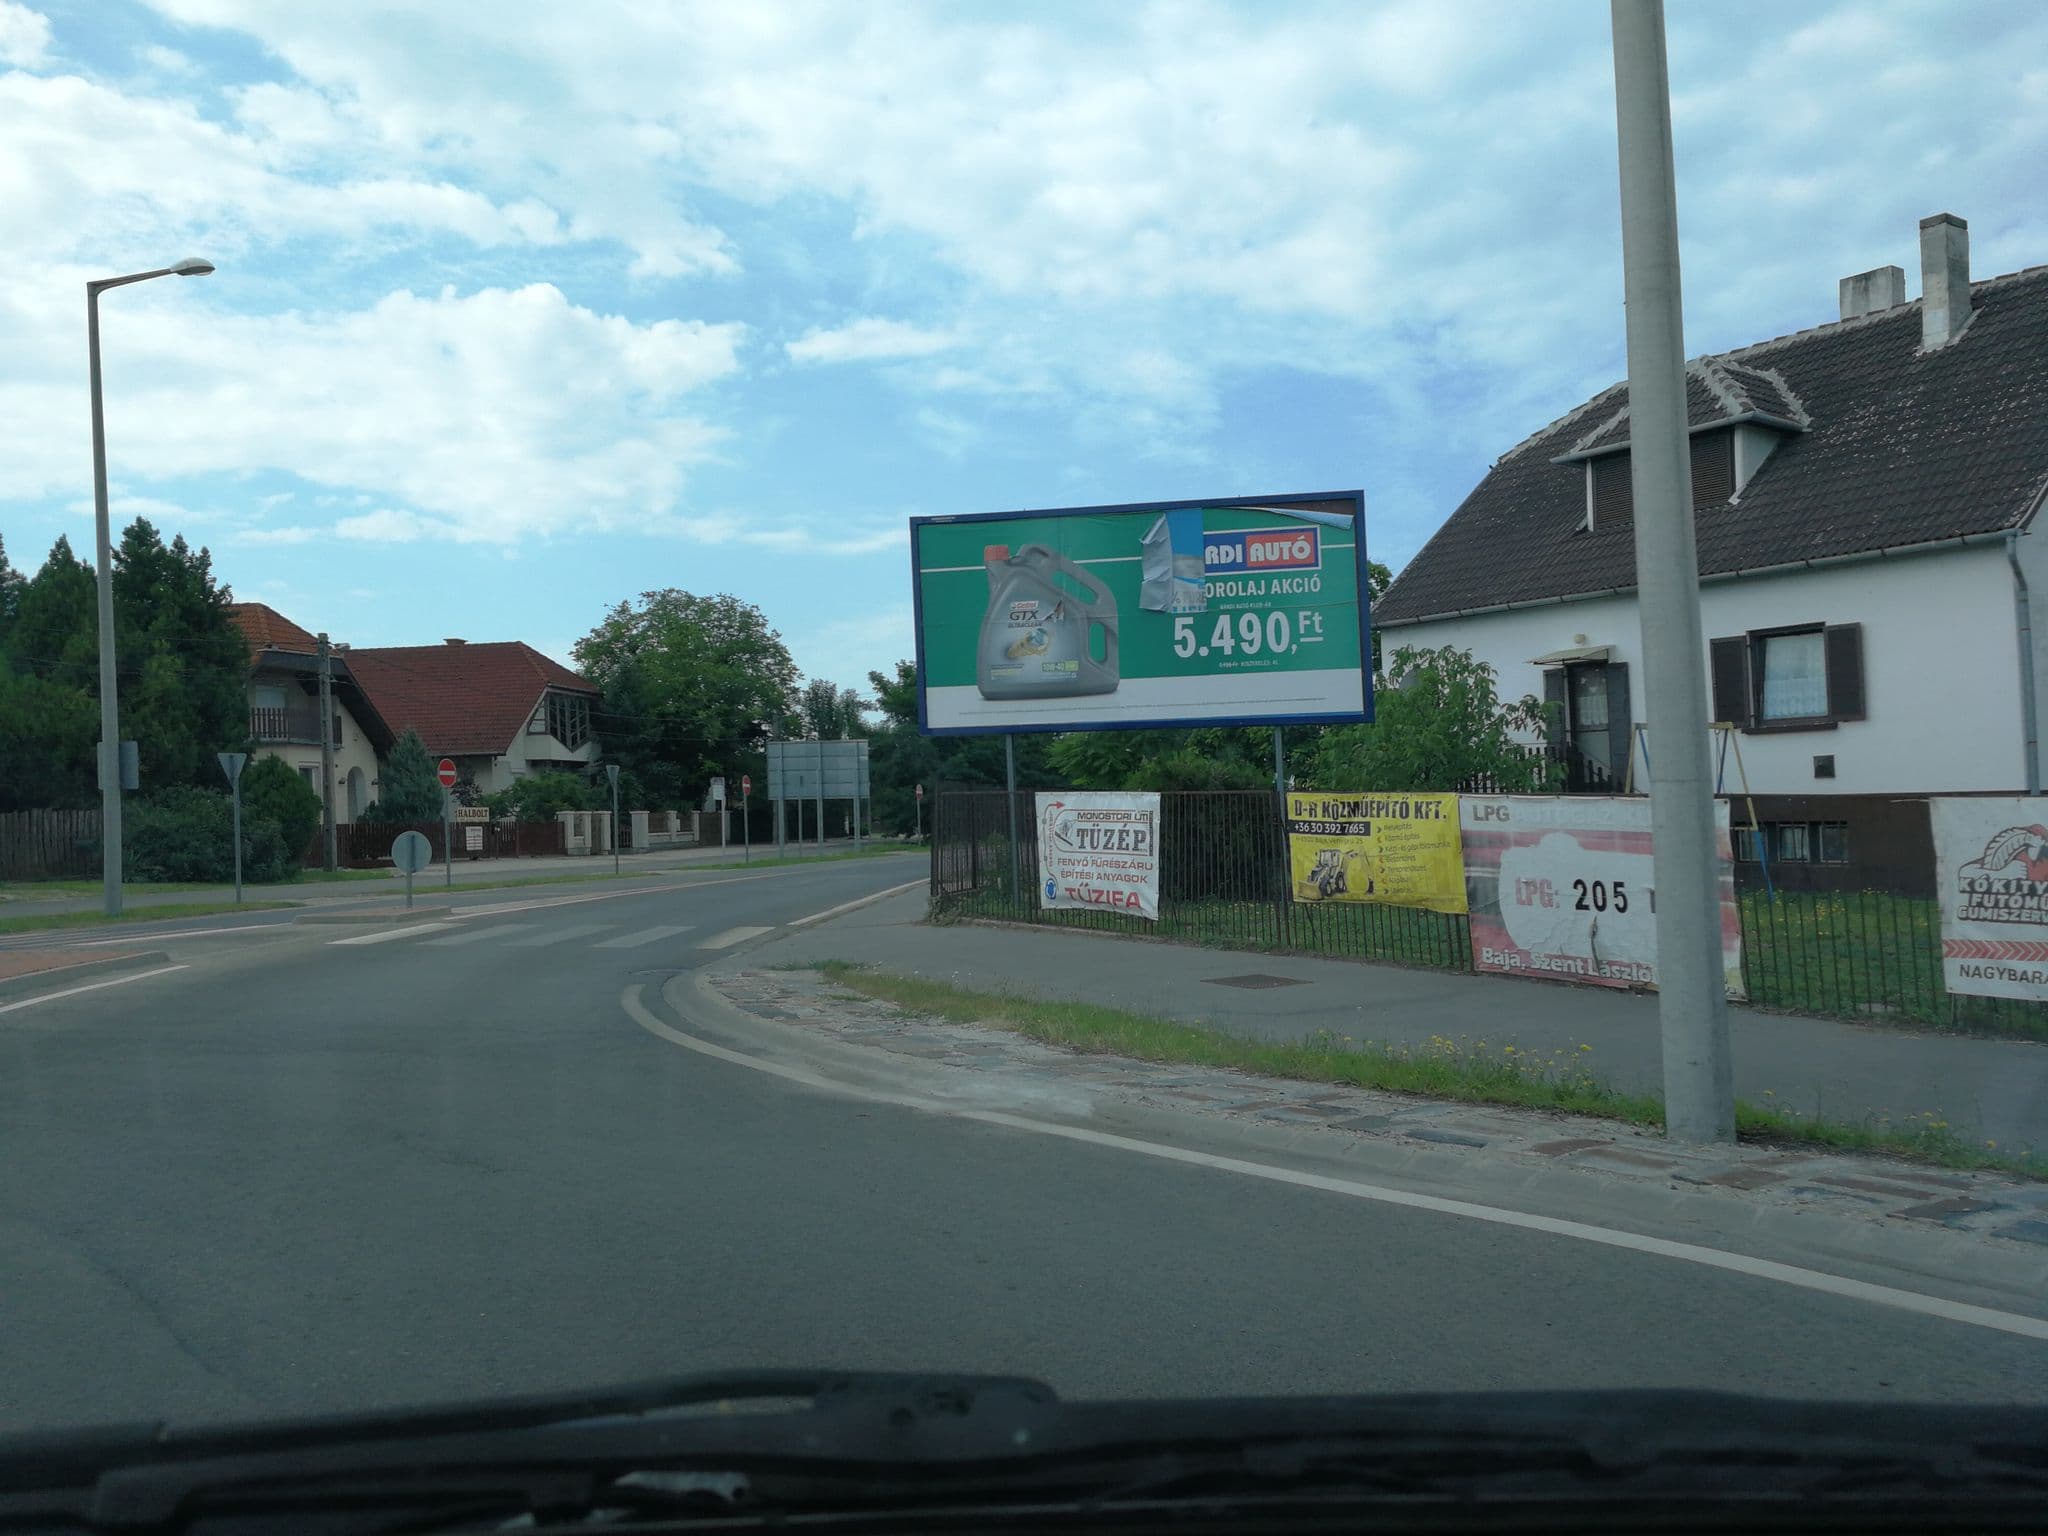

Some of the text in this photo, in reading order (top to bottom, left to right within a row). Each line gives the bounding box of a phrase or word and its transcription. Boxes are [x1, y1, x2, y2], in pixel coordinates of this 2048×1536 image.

[1250, 535, 1311, 562] AUTÓ
[1271, 573, 1321, 594] AKCIÓ
[1009, 610, 1038, 621] GTX
[1299, 611, 1323, 634] Ft
[1077, 811, 1132, 821] MONOSTORI
[1322, 796, 1410, 820] KÖZMŰÉPÍTŐ
[1414, 800, 1447, 819] KFT.
[1472, 805, 1510, 822] LPG
[1311, 823, 1322, 832] 30
[1325, 823, 1341, 833] 392
[1061, 868, 1148, 884] ÉPÍTÉSI ANYAGOK
[1573, 878, 1628, 913] 205
[1530, 952, 1585, 975] Szent
[1959, 964, 2048, 984] NAGYBAR
